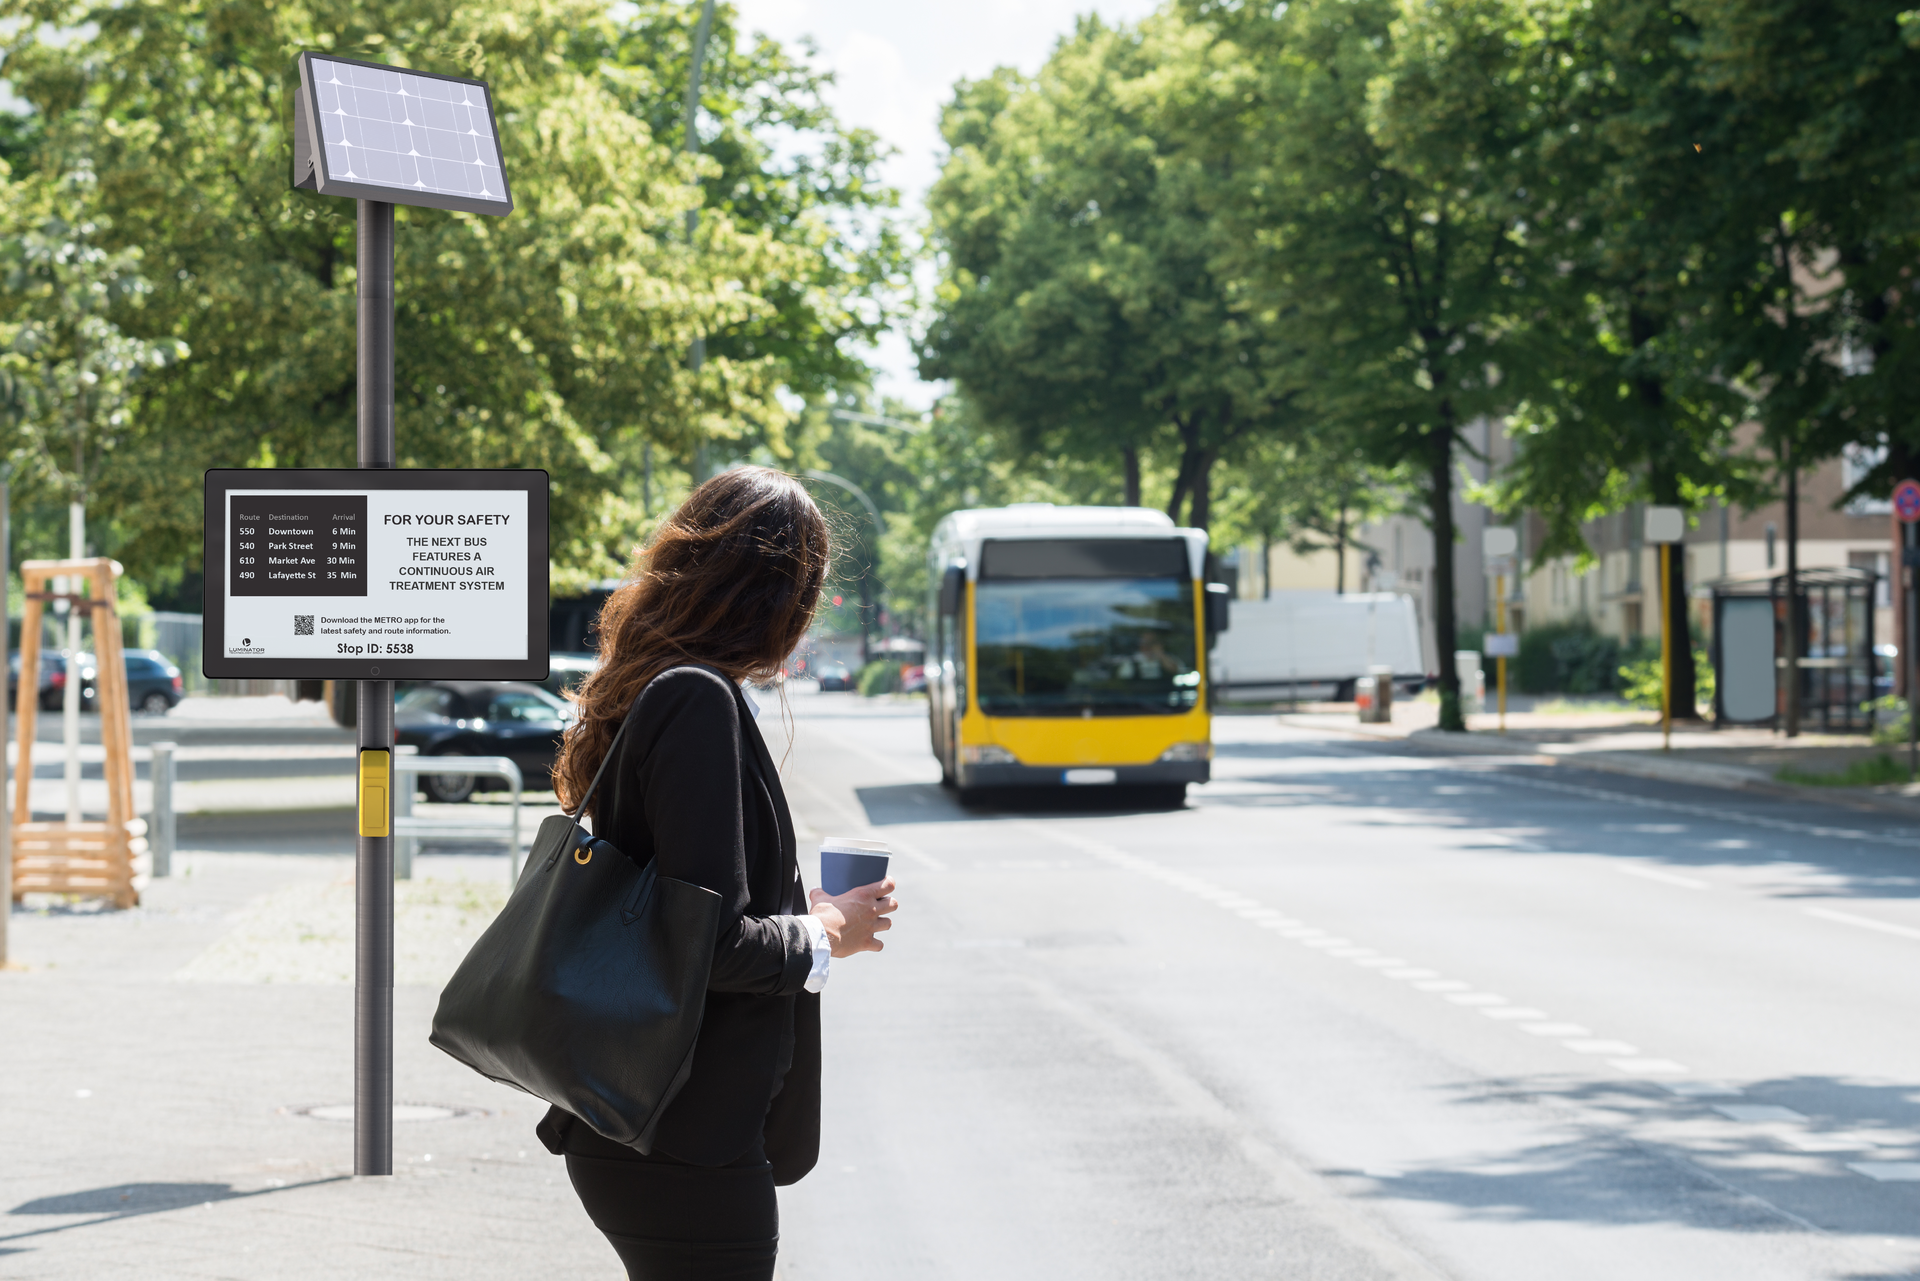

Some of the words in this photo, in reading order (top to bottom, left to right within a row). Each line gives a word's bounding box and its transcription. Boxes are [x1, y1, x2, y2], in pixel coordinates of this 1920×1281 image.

[239, 513, 261, 521] Route
[268, 513, 309, 521] Destination
[332, 513, 356, 521] Arrival
[384, 514, 412, 526] FOR
[415, 514, 454, 526] YOUR
[457, 514, 510, 526] SAFETY
[239, 527, 255, 536] 550
[268, 527, 314, 536] Downtown
[332, 527, 338, 536] 6
[339, 527, 356, 536] Min
[239, 542, 255, 550] 540
[268, 542, 287, 550] Park
[288, 542, 314, 550] Street
[332, 542, 338, 550] 9
[339, 542, 356, 550] Min
[406, 537, 429, 547] THE
[431, 537, 462, 547] NEXT
[464, 537, 488, 547] BUS
[239, 556, 255, 565] 610
[268, 556, 299, 565] Market
[300, 556, 316, 565] Ave
[326, 556, 338, 565] 30
[339, 556, 355, 565] Min
[412, 551, 471, 562] FEATURES
[473, 551, 482, 562] A
[239, 571, 255, 579] 490
[268, 571, 306, 581] Lafayette
[307, 571, 317, 579] St
[326, 571, 337, 579] 35
[340, 571, 357, 579] Min
[398, 566, 474, 576] CONTINUOUS
[475, 566, 495, 576] AIR
[388, 581, 457, 591] TREATMENT
[459, 581, 505, 591] SYSTEM
[320, 616, 359, 624] Download
[360, 616, 373, 624] the
[374, 616, 403, 624] METRO
[404, 617, 419, 625] app
[420, 616, 431, 624] for
[432, 616, 445, 624] the
[320, 627, 342, 635] latest
[343, 627, 367, 636] safety
[368, 627, 383, 635] and
[384, 627, 405, 635] route
[406, 627, 451, 635] information.
[337, 642, 364, 656] Stop
[367, 643, 383, 654] ID:
[385, 643, 414, 654] 5538
